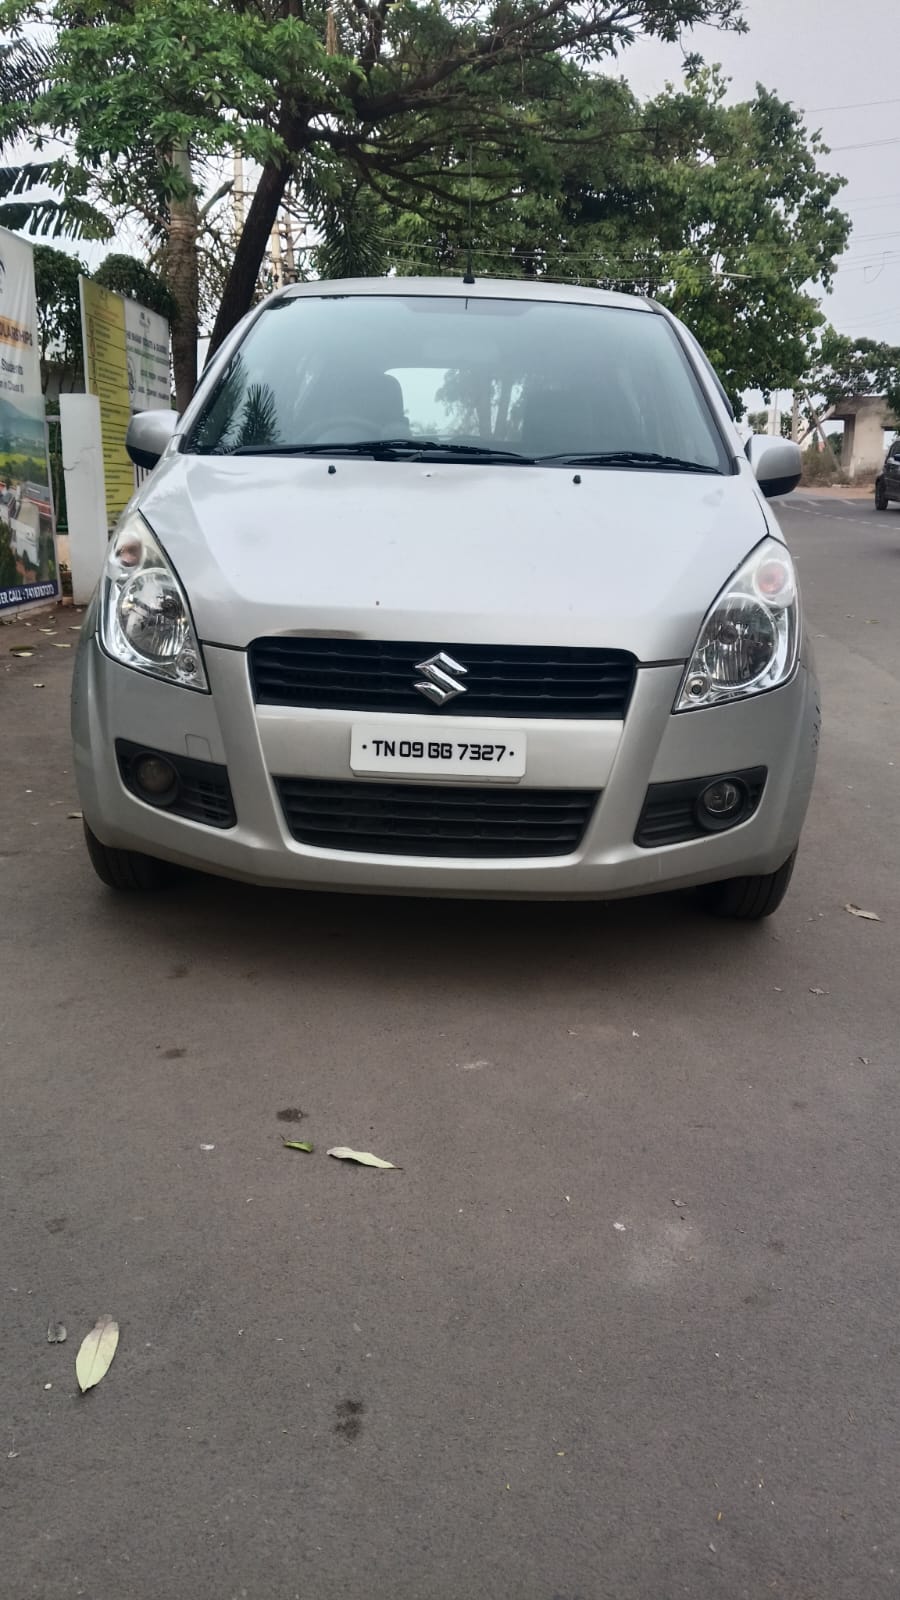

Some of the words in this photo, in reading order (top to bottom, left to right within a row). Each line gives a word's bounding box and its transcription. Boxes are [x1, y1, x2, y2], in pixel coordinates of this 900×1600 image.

[9, 589, 22, 602] CALL
[372, 740, 396, 757] TN
[400, 741, 424, 758] 09
[457, 743, 506, 762] 7327
